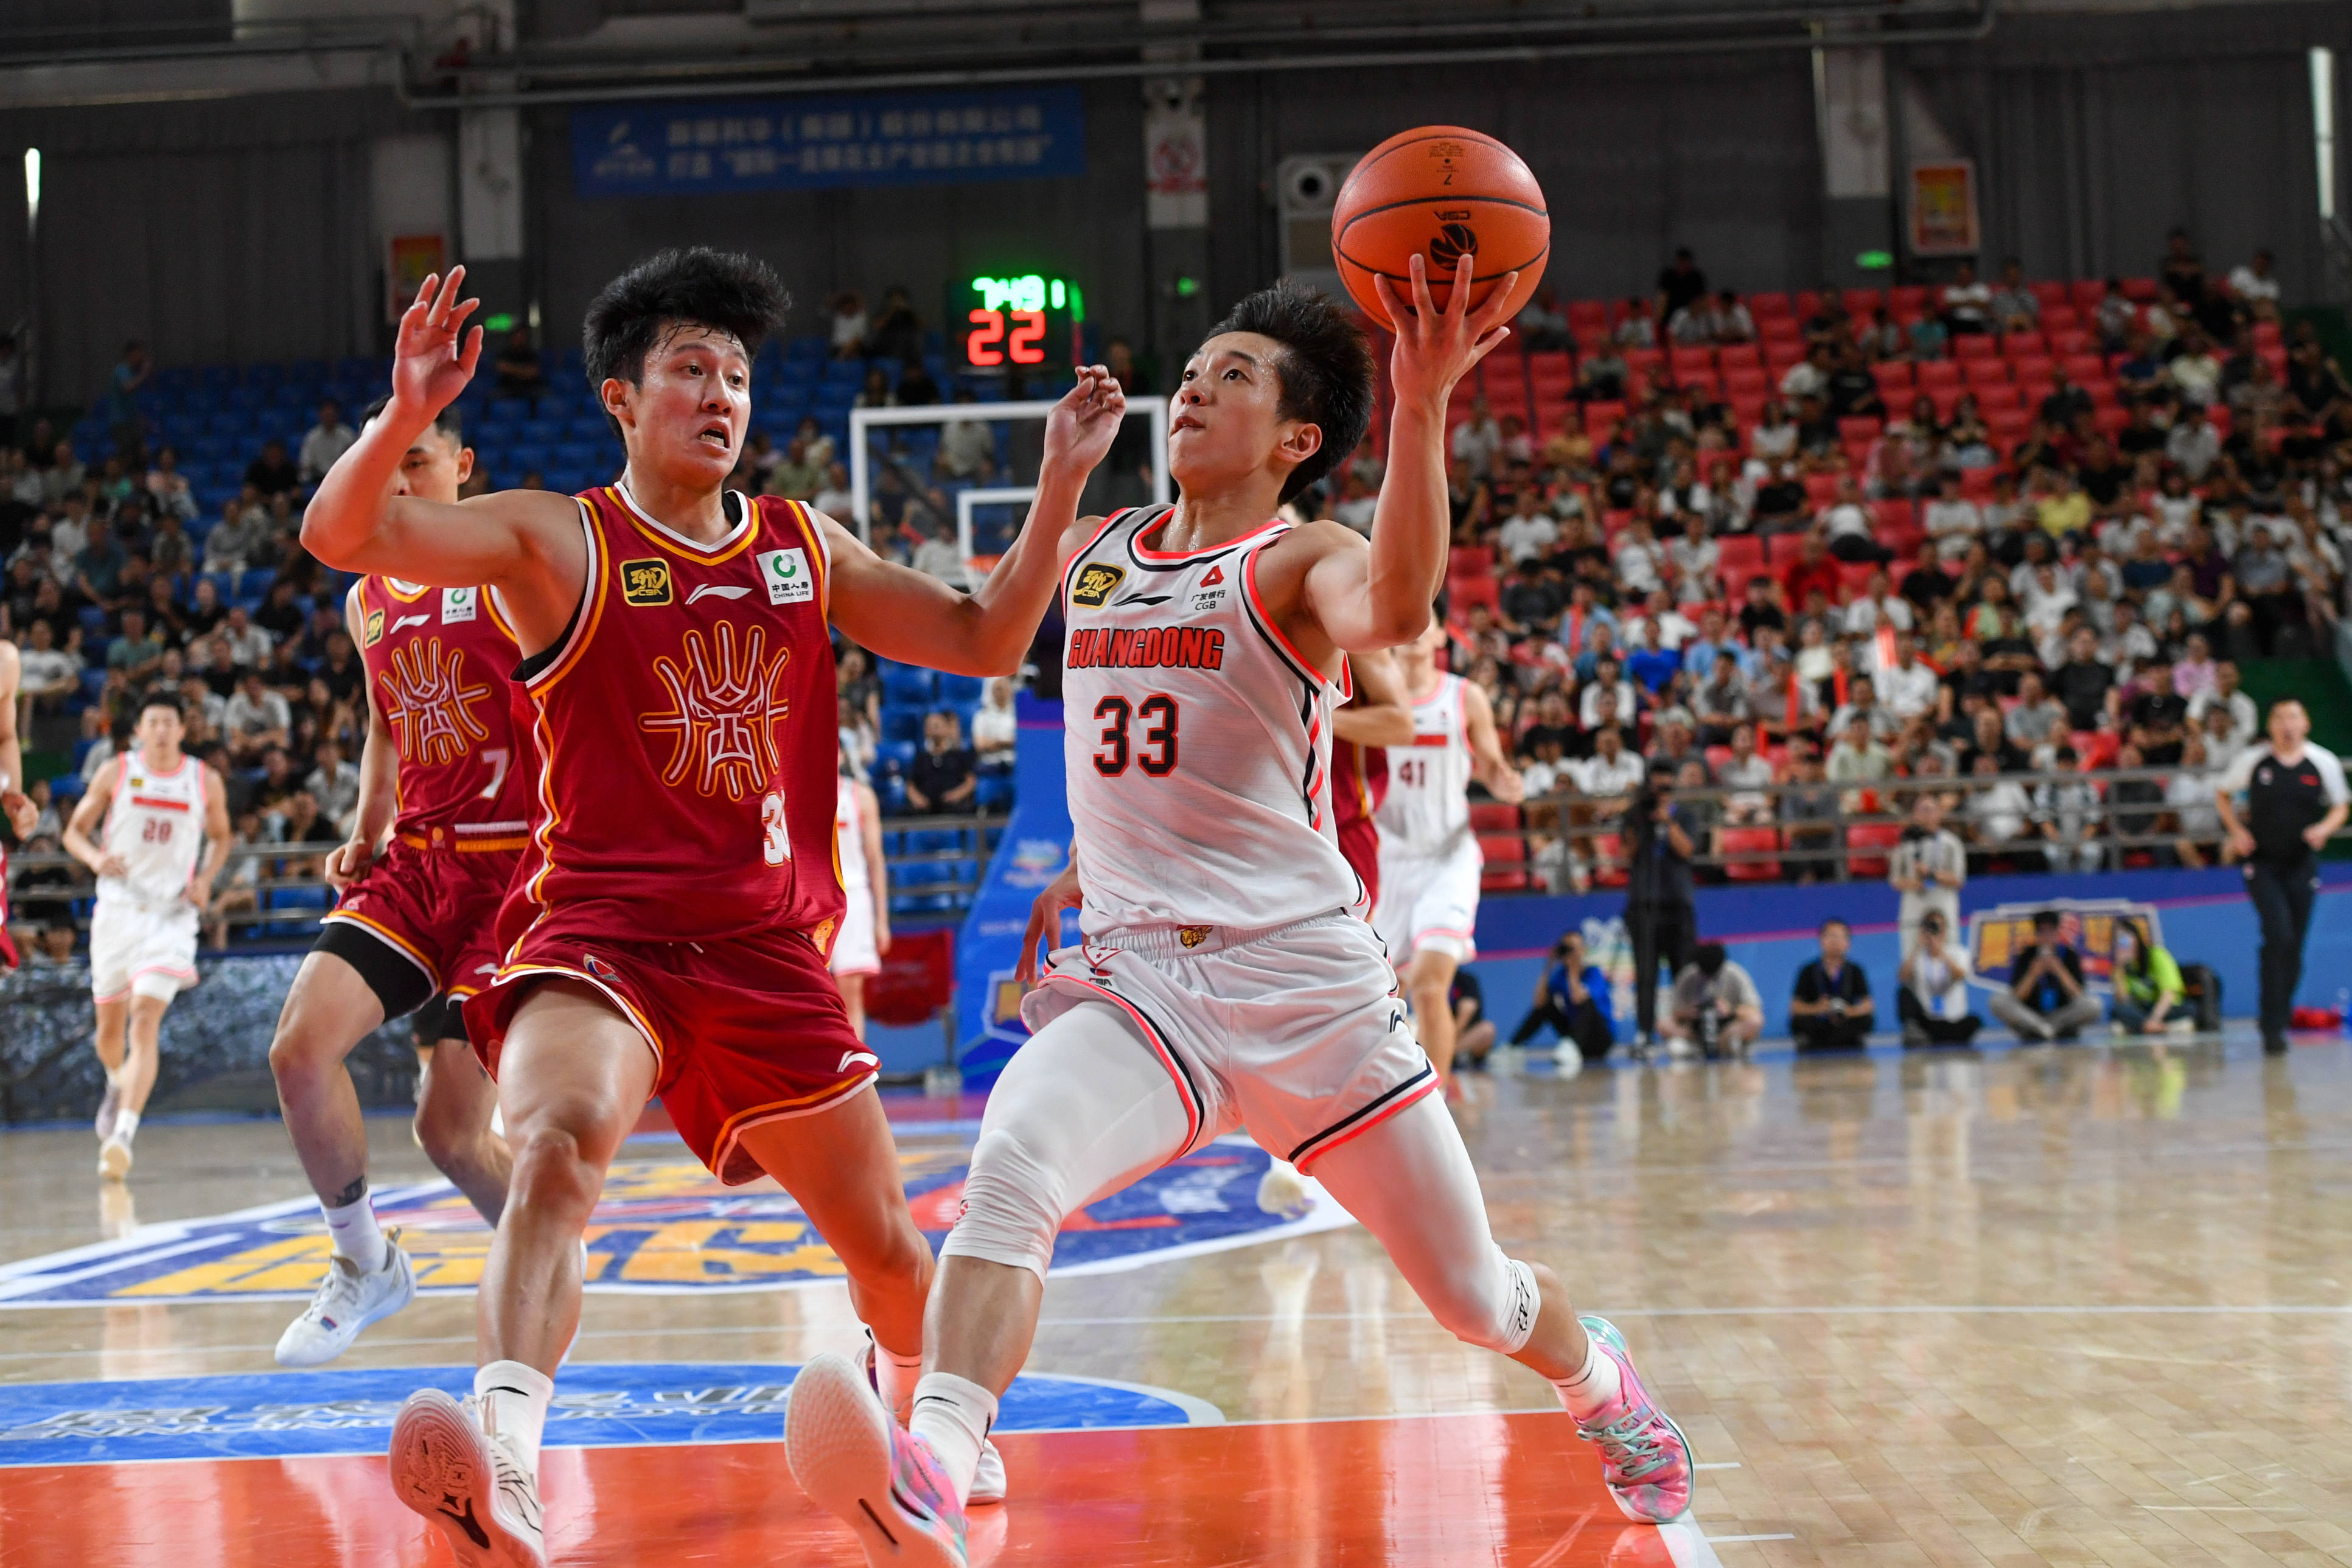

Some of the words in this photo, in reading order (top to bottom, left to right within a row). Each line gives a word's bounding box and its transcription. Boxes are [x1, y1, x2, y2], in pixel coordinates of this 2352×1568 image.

[968, 308, 1045, 367] 22
[1191, 590, 1226, 602] 广发银行
[1195, 601, 1216, 611] CGB
[1067, 627, 1225, 671] GUANGDONG
[1093, 693, 1179, 778] 33
[480, 747, 510, 800] 7
[1398, 761, 1426, 788] 41
